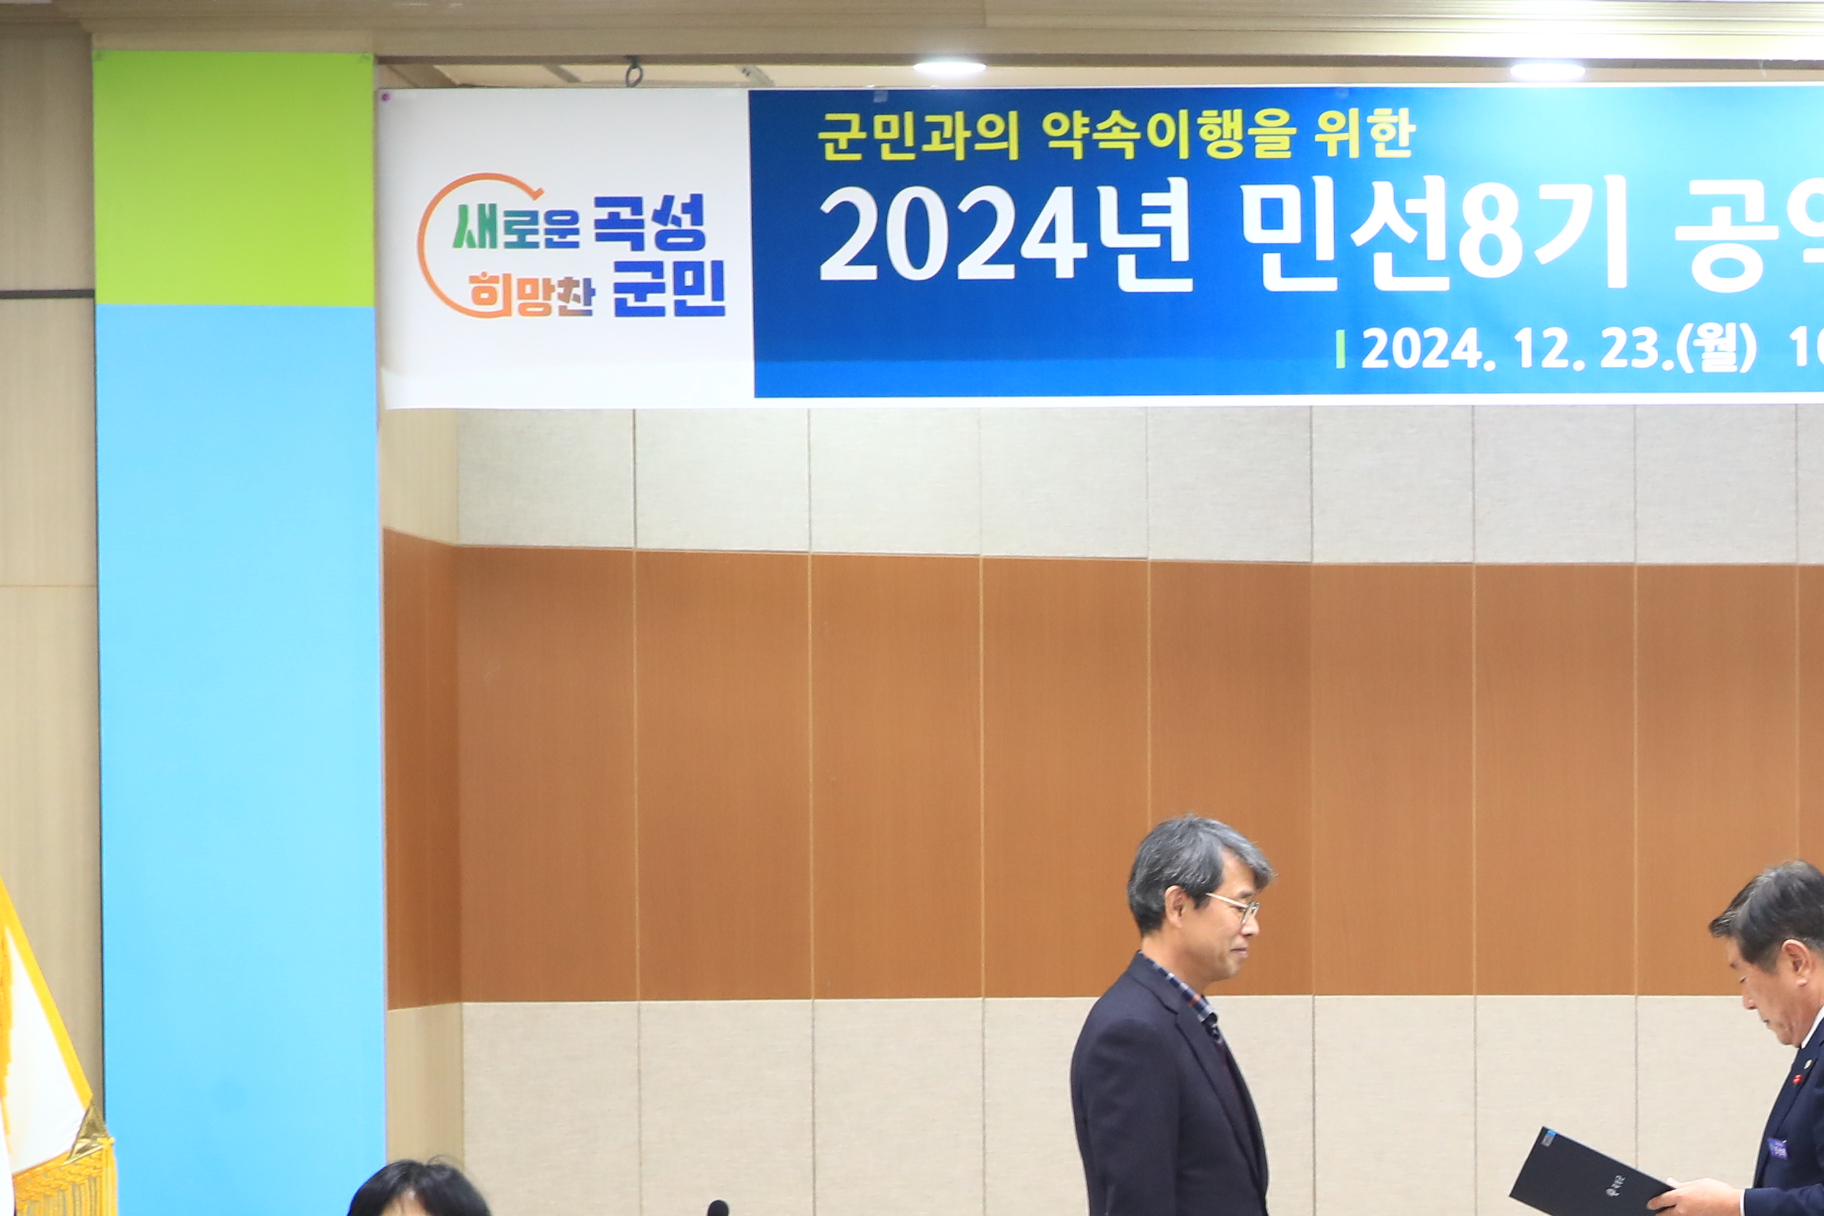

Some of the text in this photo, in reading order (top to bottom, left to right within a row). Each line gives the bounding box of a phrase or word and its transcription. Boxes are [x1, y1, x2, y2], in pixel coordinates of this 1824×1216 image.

[818, 107, 1417, 162] 군민과의 약속이행을 위한
[453, 193, 706, 252] 새로운 곡성
[819, 175, 1194, 293] 2024년
[1241, 173, 1630, 293] 민선8기
[468, 259, 726, 319] 희망찬 군민
[1361, 325, 1497, 372] 2024.
[1514, 326, 1587, 372] 12.
[1600, 321, 1759, 374] 23.(월)
